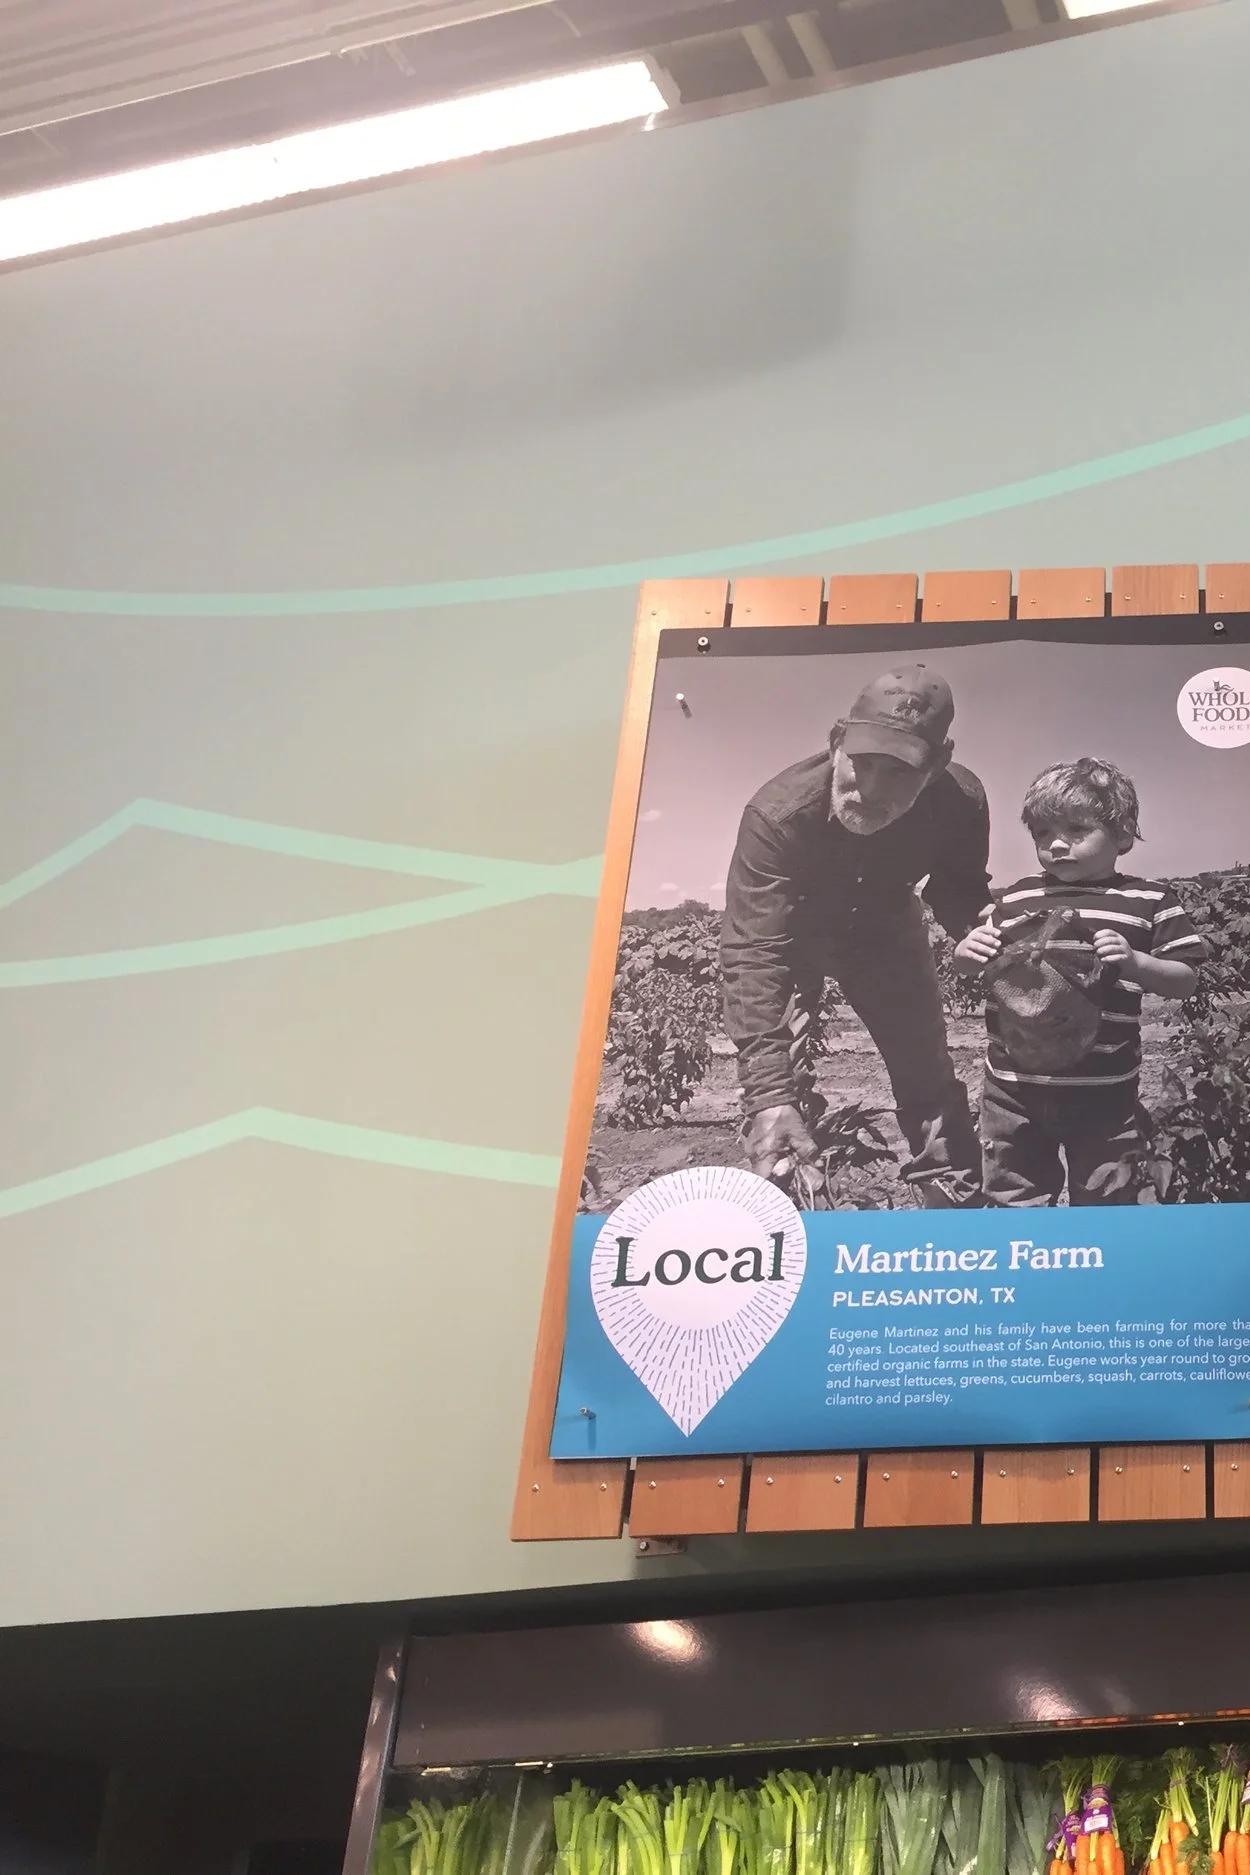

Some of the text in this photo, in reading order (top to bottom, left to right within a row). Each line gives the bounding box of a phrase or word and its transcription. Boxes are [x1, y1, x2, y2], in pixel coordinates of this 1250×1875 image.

[611, 1231, 785, 1287] Local
[834, 1240, 1105, 1274] Martinez Farm
[832, 1287, 1015, 1307] PLEASANTON, TX
[829, 1327, 878, 1342] Eugene
[884, 1326, 939, 1338] Martinez
[944, 1324, 969, 1336] and
[974, 1324, 992, 1335] his
[998, 1322, 1036, 1337] family
[1041, 1322, 1071, 1334] have
[1077, 1322, 1109, 1333] been
[1116, 1320, 1164, 1334] farming
[1170, 1319, 1188, 1331] for
[1194, 1321, 1227, 1331] more
[828, 1344, 844, 1356] 40
[888, 1341, 939, 1354] Located
[943, 1341, 1004, 1353] southeast
[1008, 1339, 1022, 1351] of
[1024, 1339, 1048, 1351] San
[1052, 1339, 1105, 1350] Antonio,
[1109, 1337, 1132, 1348] this
[1135, 1336, 1145, 1348] is
[1149, 1338, 1173, 1347] one
[1177, 1335, 1191, 1347] of
[1194, 1337, 1214, 1347] the
[827, 1359, 879, 1373] certified
[883, 1359, 931, 1373] organic
[934, 1357, 969, 1369] farms
[972, 1357, 984, 1368] in
[988, 1356, 1008, 1368] the
[1011, 1356, 1044, 1368] state.
[1048, 1355, 1097, 1369] Eugene
[1100, 1353, 1137, 1365] works
[1140, 1356, 1168, 1368] year
[1171, 1352, 1209, 1364] round
[1212, 1353, 1225, 1364] to
[826, 1376, 850, 1389] and
[855, 1375, 901, 1388] harvest
[904, 1374, 956, 1387] lettuces,
[960, 1374, 1008, 1388] greens,
[1010, 1370, 1085, 1384] cucumbers,
[1088, 1370, 1136, 1384] squash,
[1140, 1370, 1186, 1382] carrots,
[825, 1390, 953, 1406] cilantro and parsley.
